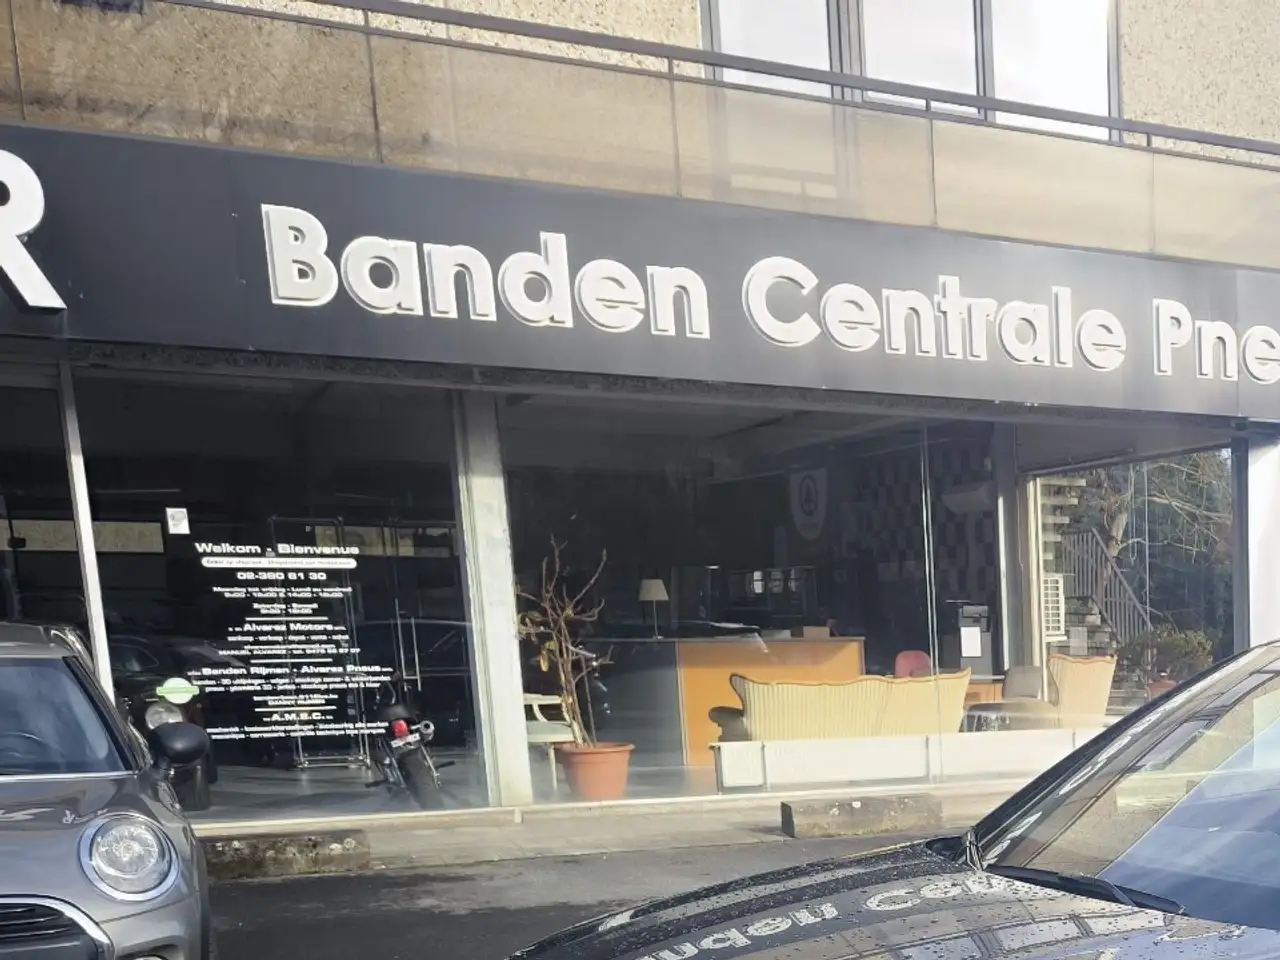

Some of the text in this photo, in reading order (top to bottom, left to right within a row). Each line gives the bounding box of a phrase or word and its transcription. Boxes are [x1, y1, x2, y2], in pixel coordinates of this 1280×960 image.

[261, 203, 711, 341] Banden
[741, 255, 1126, 372] Centrale
[195, 542, 260, 555] Welkom
[277, 543, 359, 555] Bienvenue
[243, 623, 286, 631] Alvarez
[290, 623, 333, 631] Motors
[202, 667, 246, 675] Banden
[250, 666, 290, 675] Rijmen
[301, 665, 343, 673] Alvarez
[346, 664, 380, 672] Pneus
